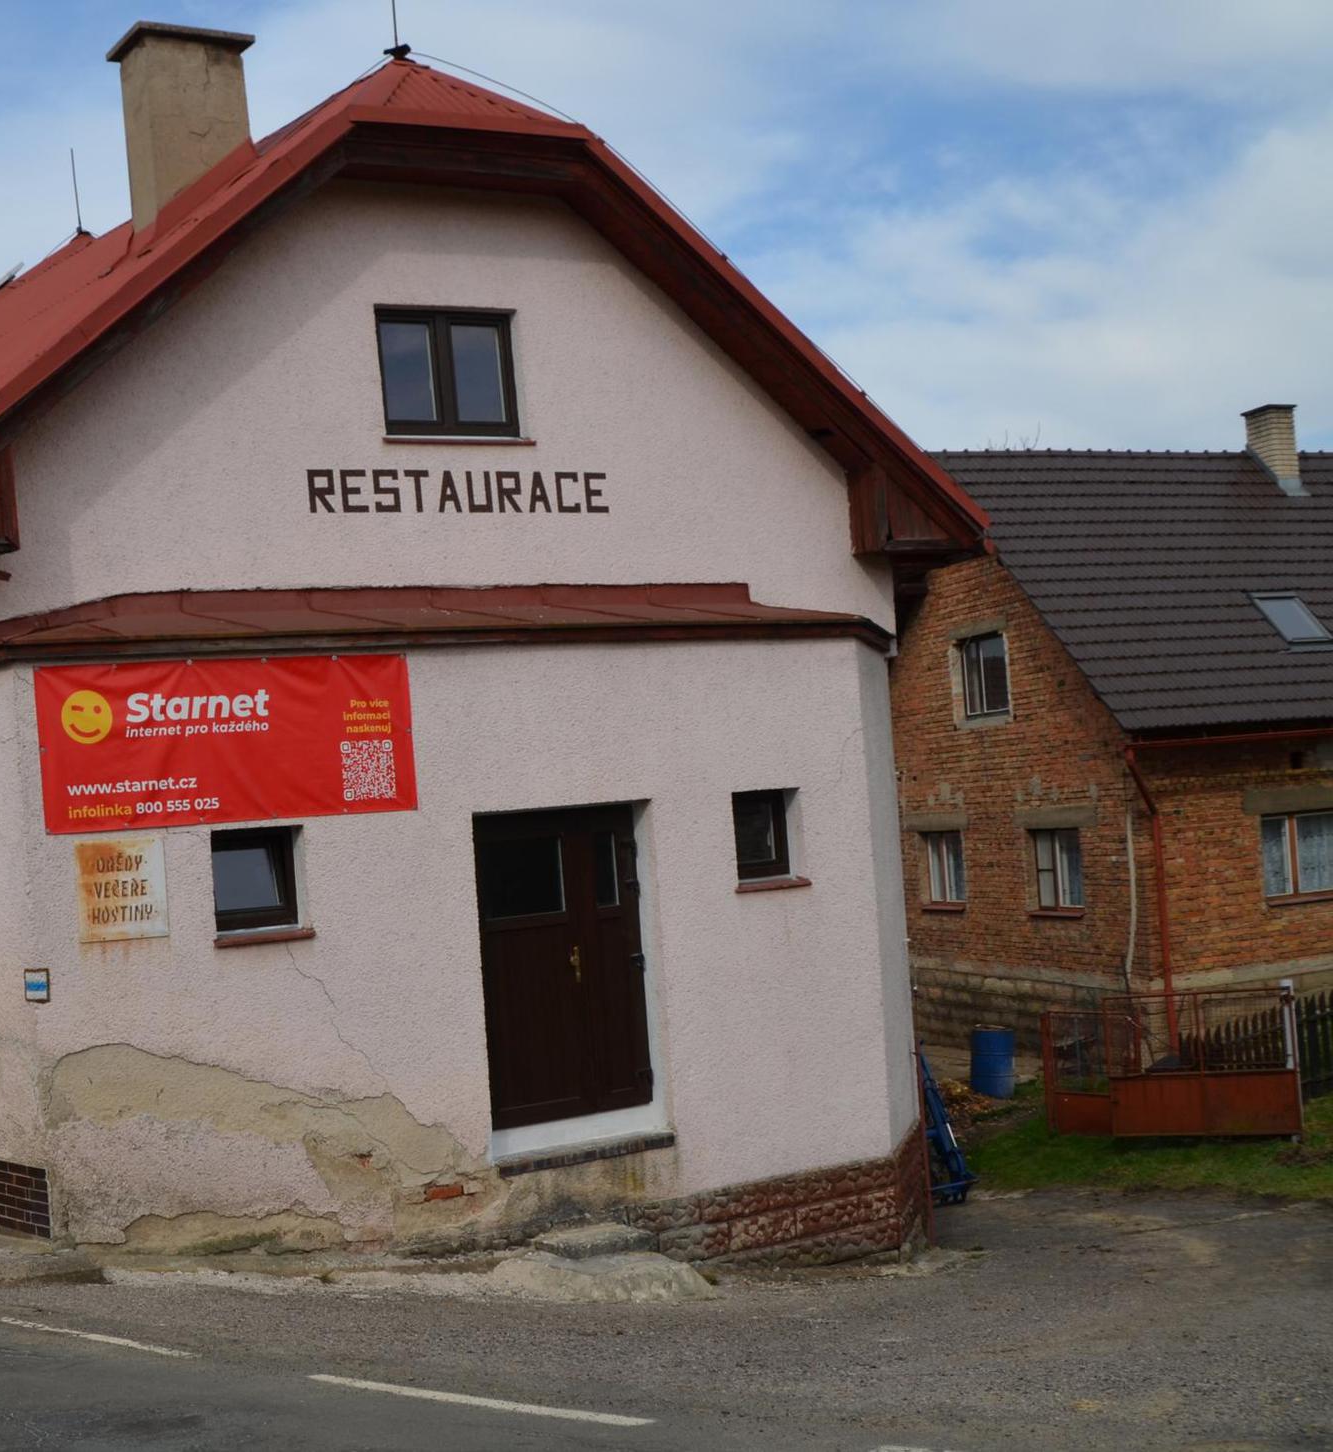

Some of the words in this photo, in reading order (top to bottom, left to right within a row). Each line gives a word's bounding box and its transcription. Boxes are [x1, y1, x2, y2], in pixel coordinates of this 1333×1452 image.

[306, 469, 610, 513] RESTAURACE
[126, 689, 270, 723] Starnet
[350, 699, 367, 708] Pro
[125, 725, 182, 738] internet
[185, 724, 209, 737] pro
[212, 720, 269, 733] každého
[346, 722, 392, 734] naskenuj
[67, 776, 198, 796] www.starnet.cz
[68, 803, 133, 819] infolinka
[136, 801, 163, 815] 800
[166, 799, 191, 812] 555
[194, 797, 221, 810] 025
[92, 904, 152, 924] HOSTINY
